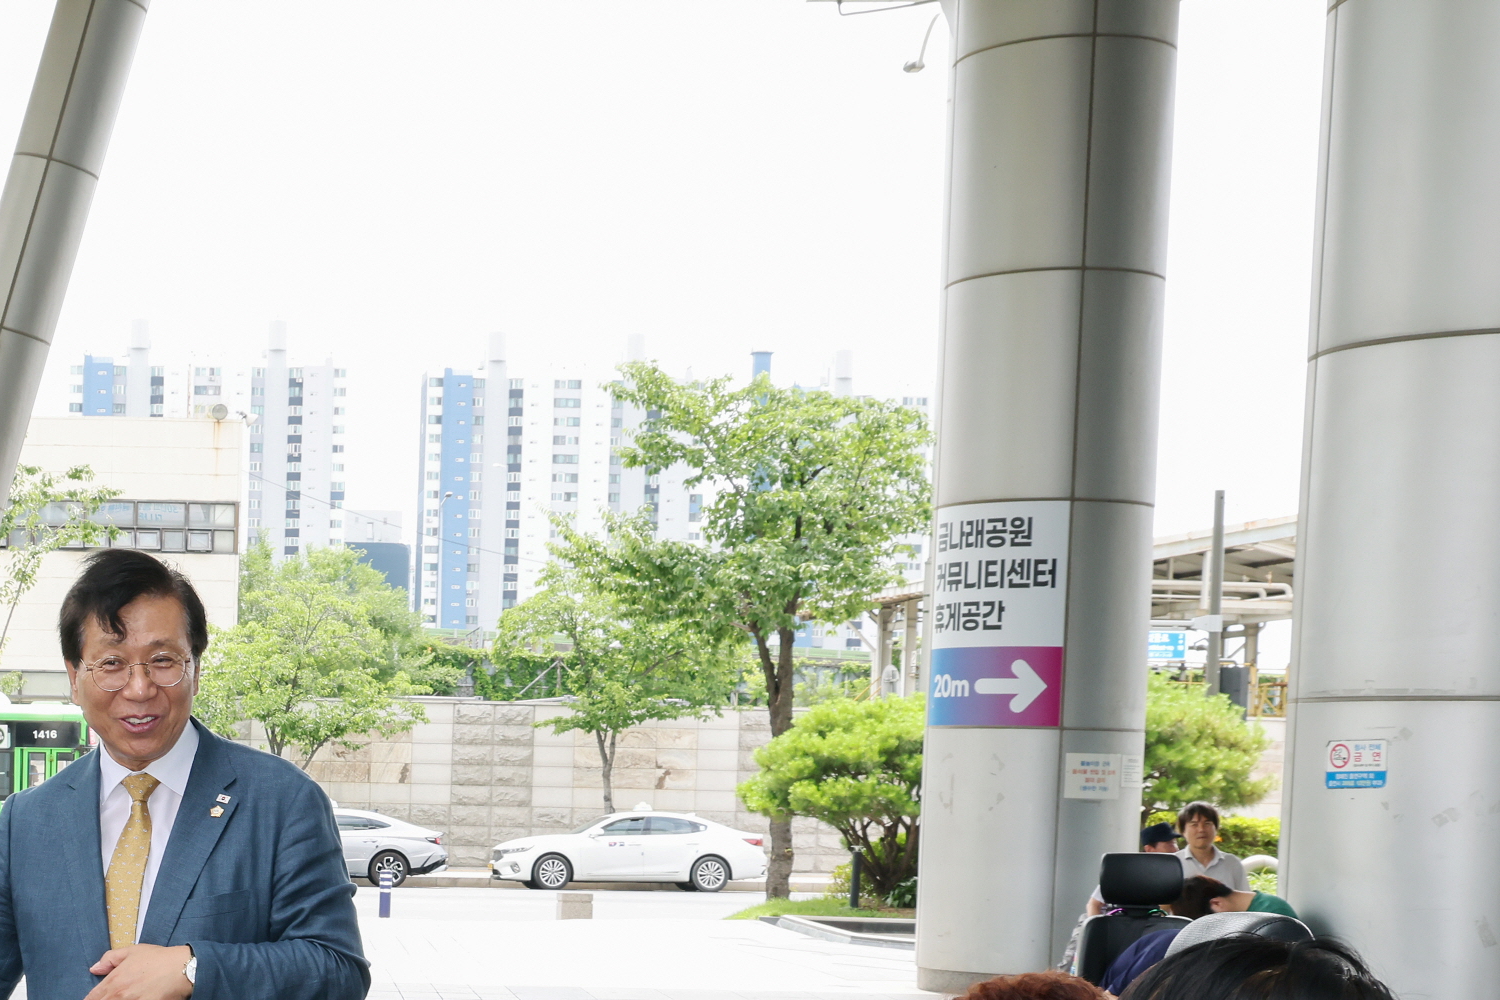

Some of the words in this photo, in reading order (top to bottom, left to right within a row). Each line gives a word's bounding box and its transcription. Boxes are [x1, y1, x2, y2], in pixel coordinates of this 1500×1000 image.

[938, 516, 1033, 552] 금나래공원
[935, 558, 1058, 592] 커뮤니티센터
[934, 600, 1006, 634] 휴게공간
[933, 673, 970, 698] 20m
[32, 730, 58, 739] 1416
[1353, 752, 1362, 762] 금
[1372, 752, 1381, 762] 연
